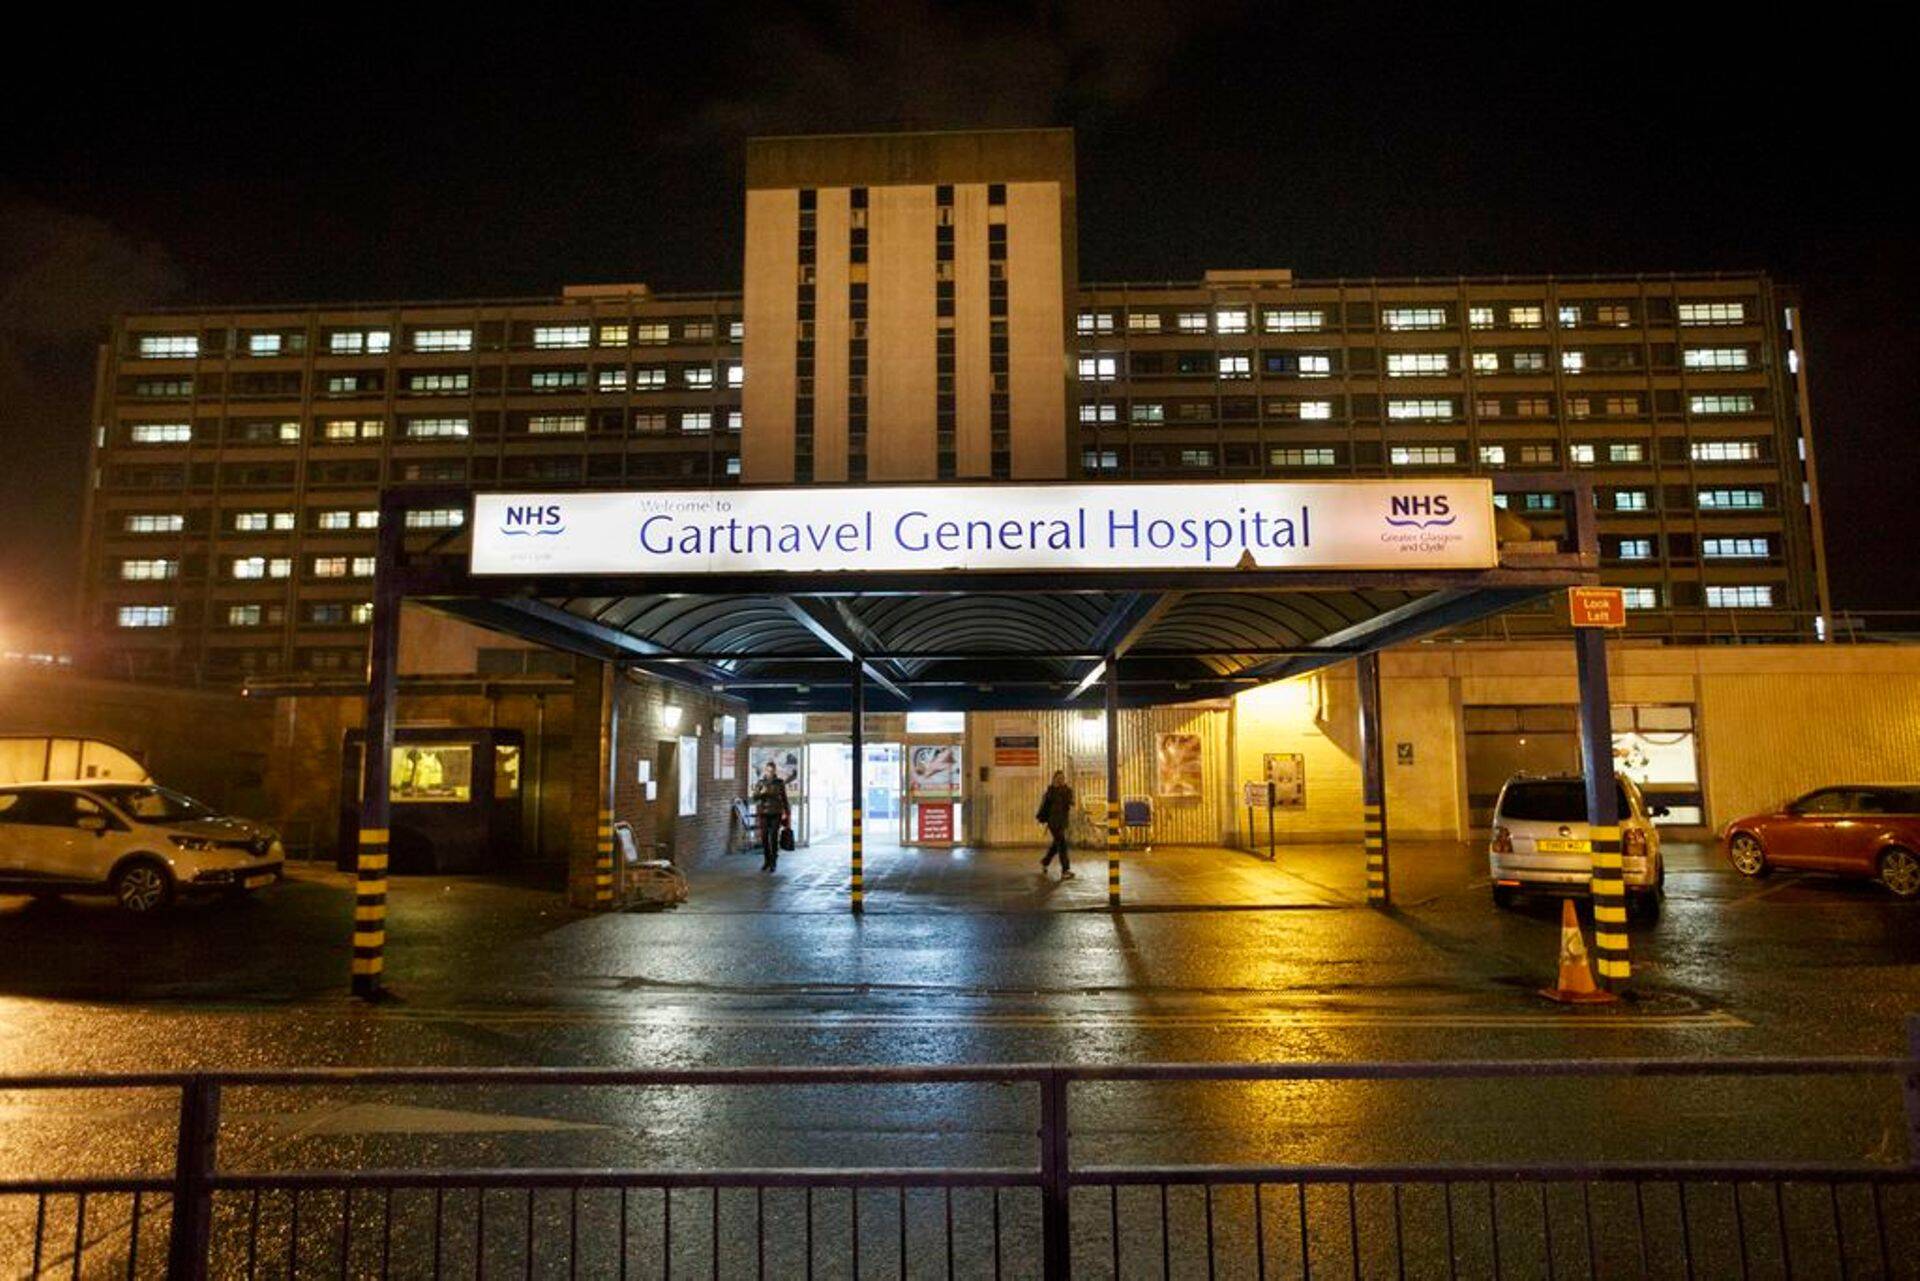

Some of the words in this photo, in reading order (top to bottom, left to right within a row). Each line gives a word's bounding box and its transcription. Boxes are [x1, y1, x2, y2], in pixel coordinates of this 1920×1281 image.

[641, 499, 709, 512] Welcome
[717, 500, 731, 512] to
[1391, 495, 1450, 516] NHS
[506, 505, 560, 525] NHS
[640, 511, 871, 554] Gartnavel
[894, 507, 1086, 552] General
[1108, 505, 1311, 562] Hospital
[1381, 533, 1417, 542] Greater
[1401, 543, 1418, 552] and
